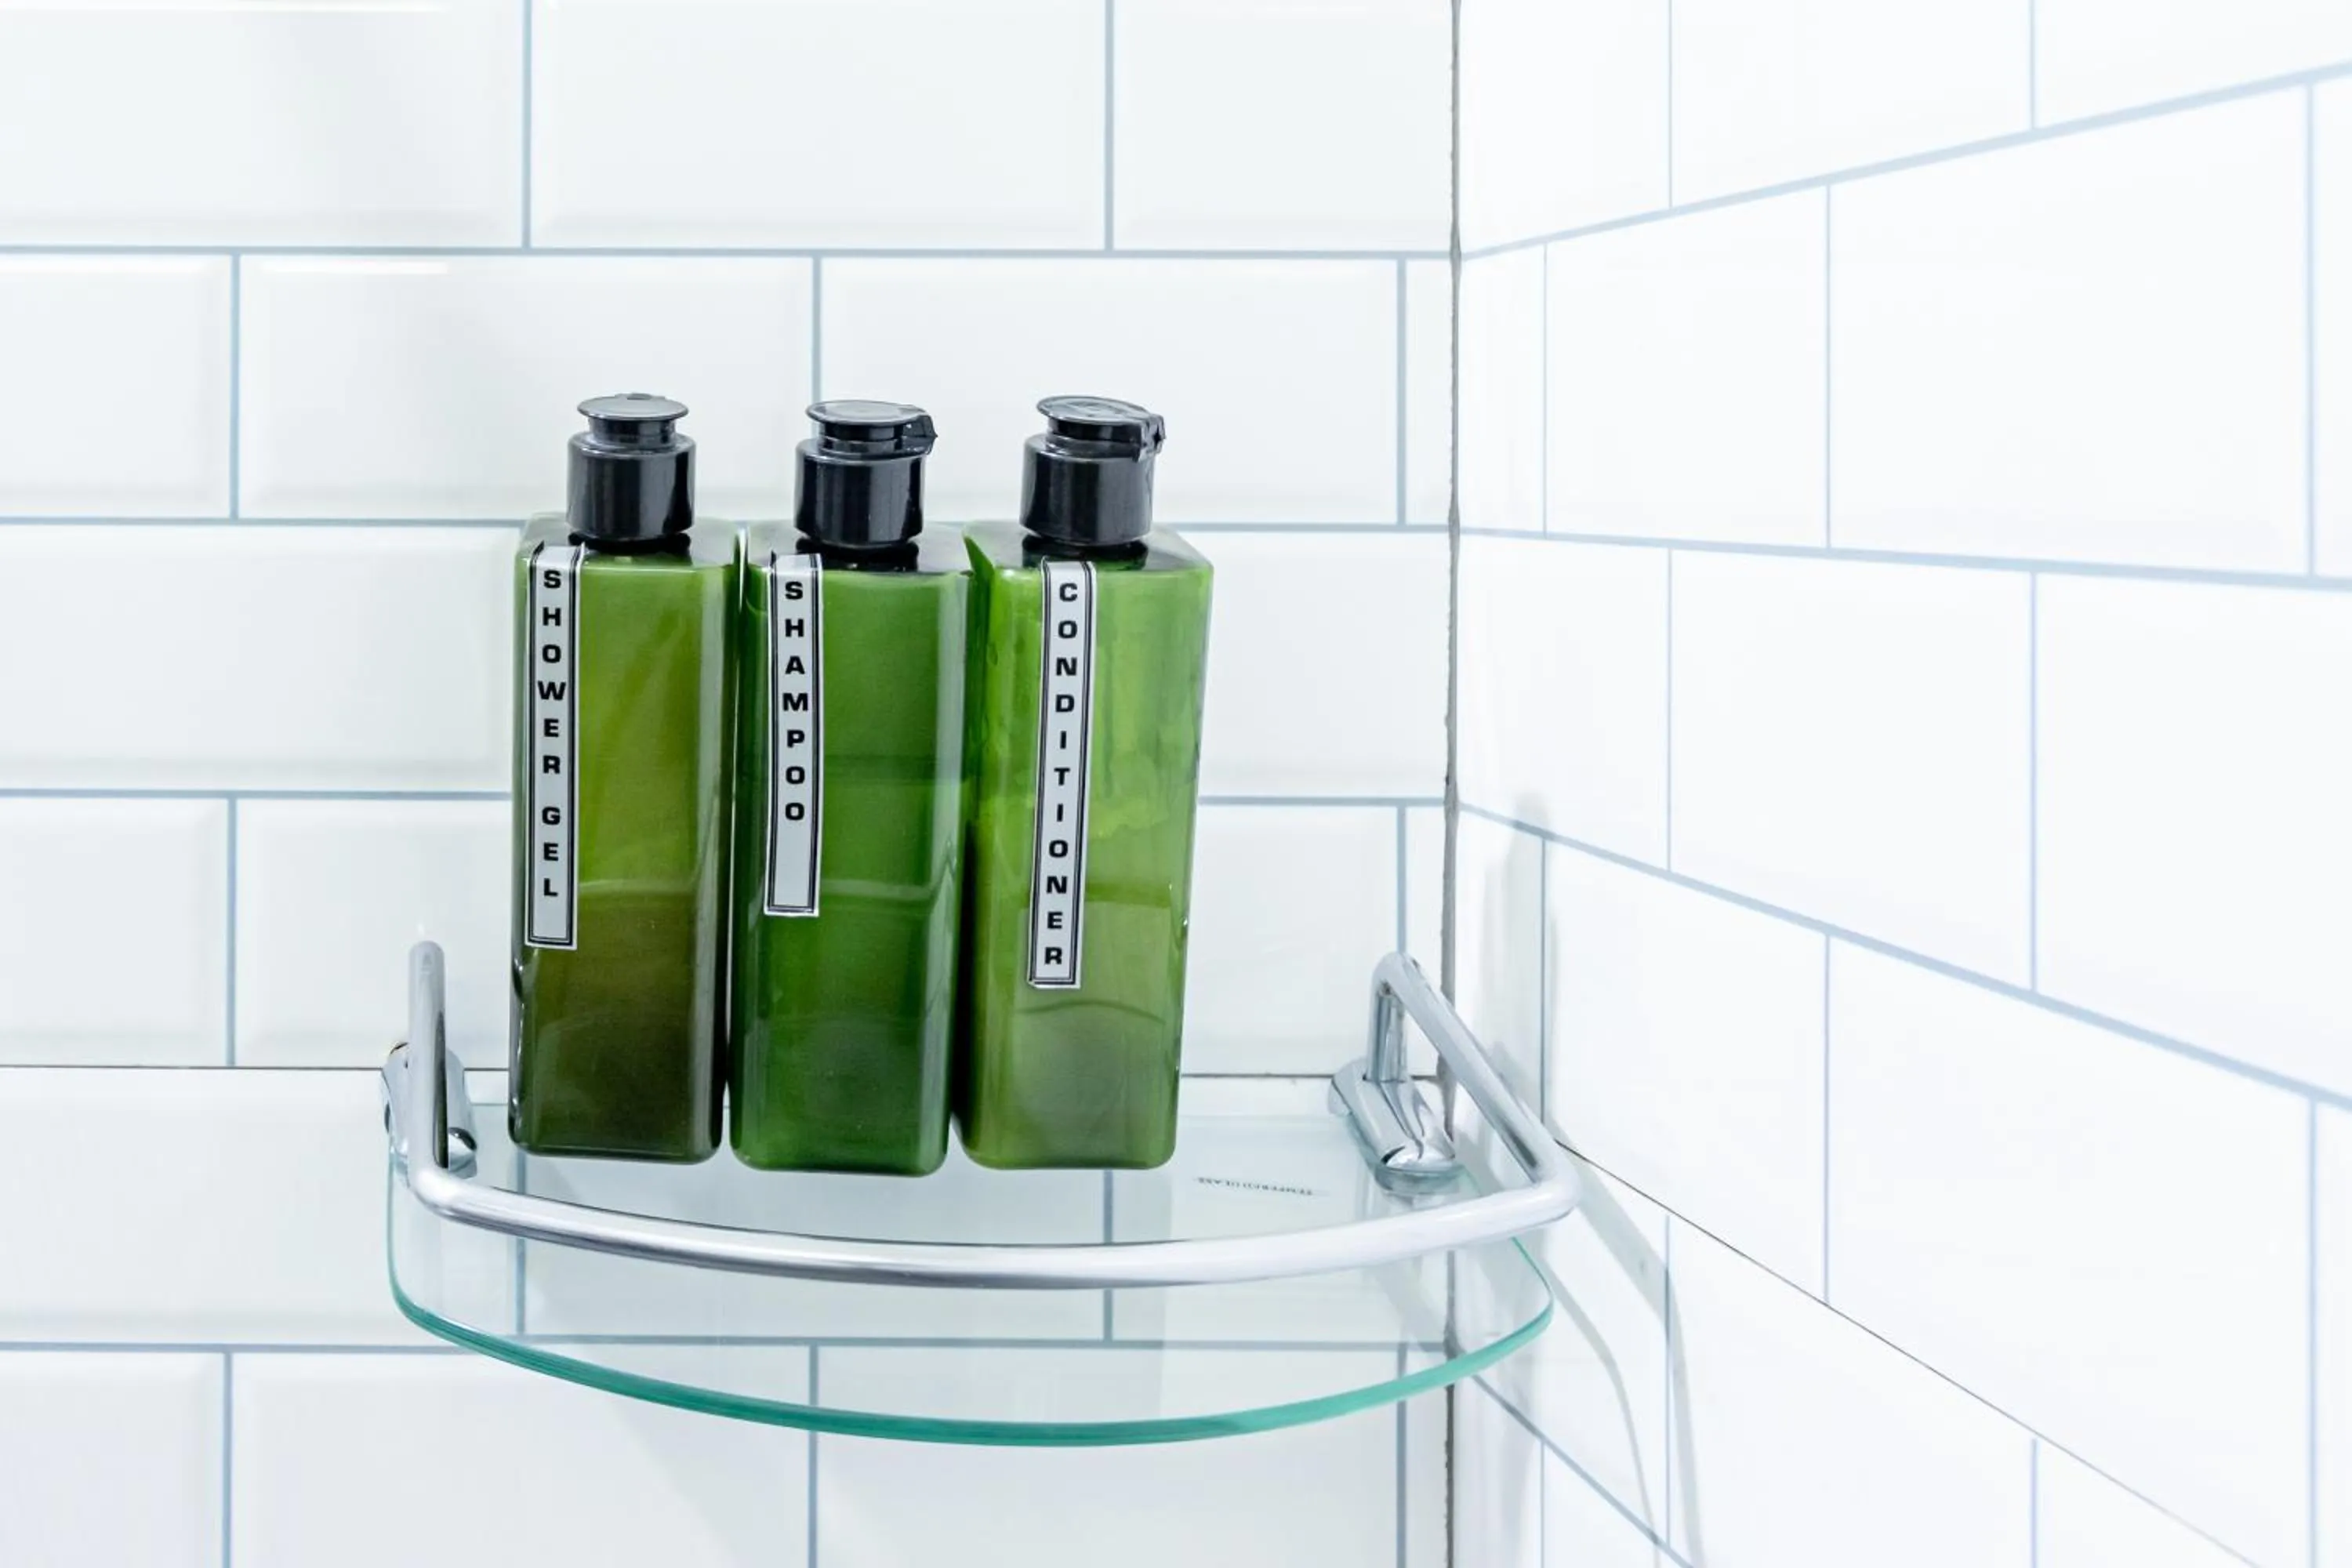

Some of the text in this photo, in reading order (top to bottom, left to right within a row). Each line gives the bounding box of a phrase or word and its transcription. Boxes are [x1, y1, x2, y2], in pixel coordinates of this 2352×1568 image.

[538, 570, 566, 898] SHOWER GEL
[782, 581, 809, 822] SHAMPOO
[1044, 583, 1078, 965] CONDITIONER
